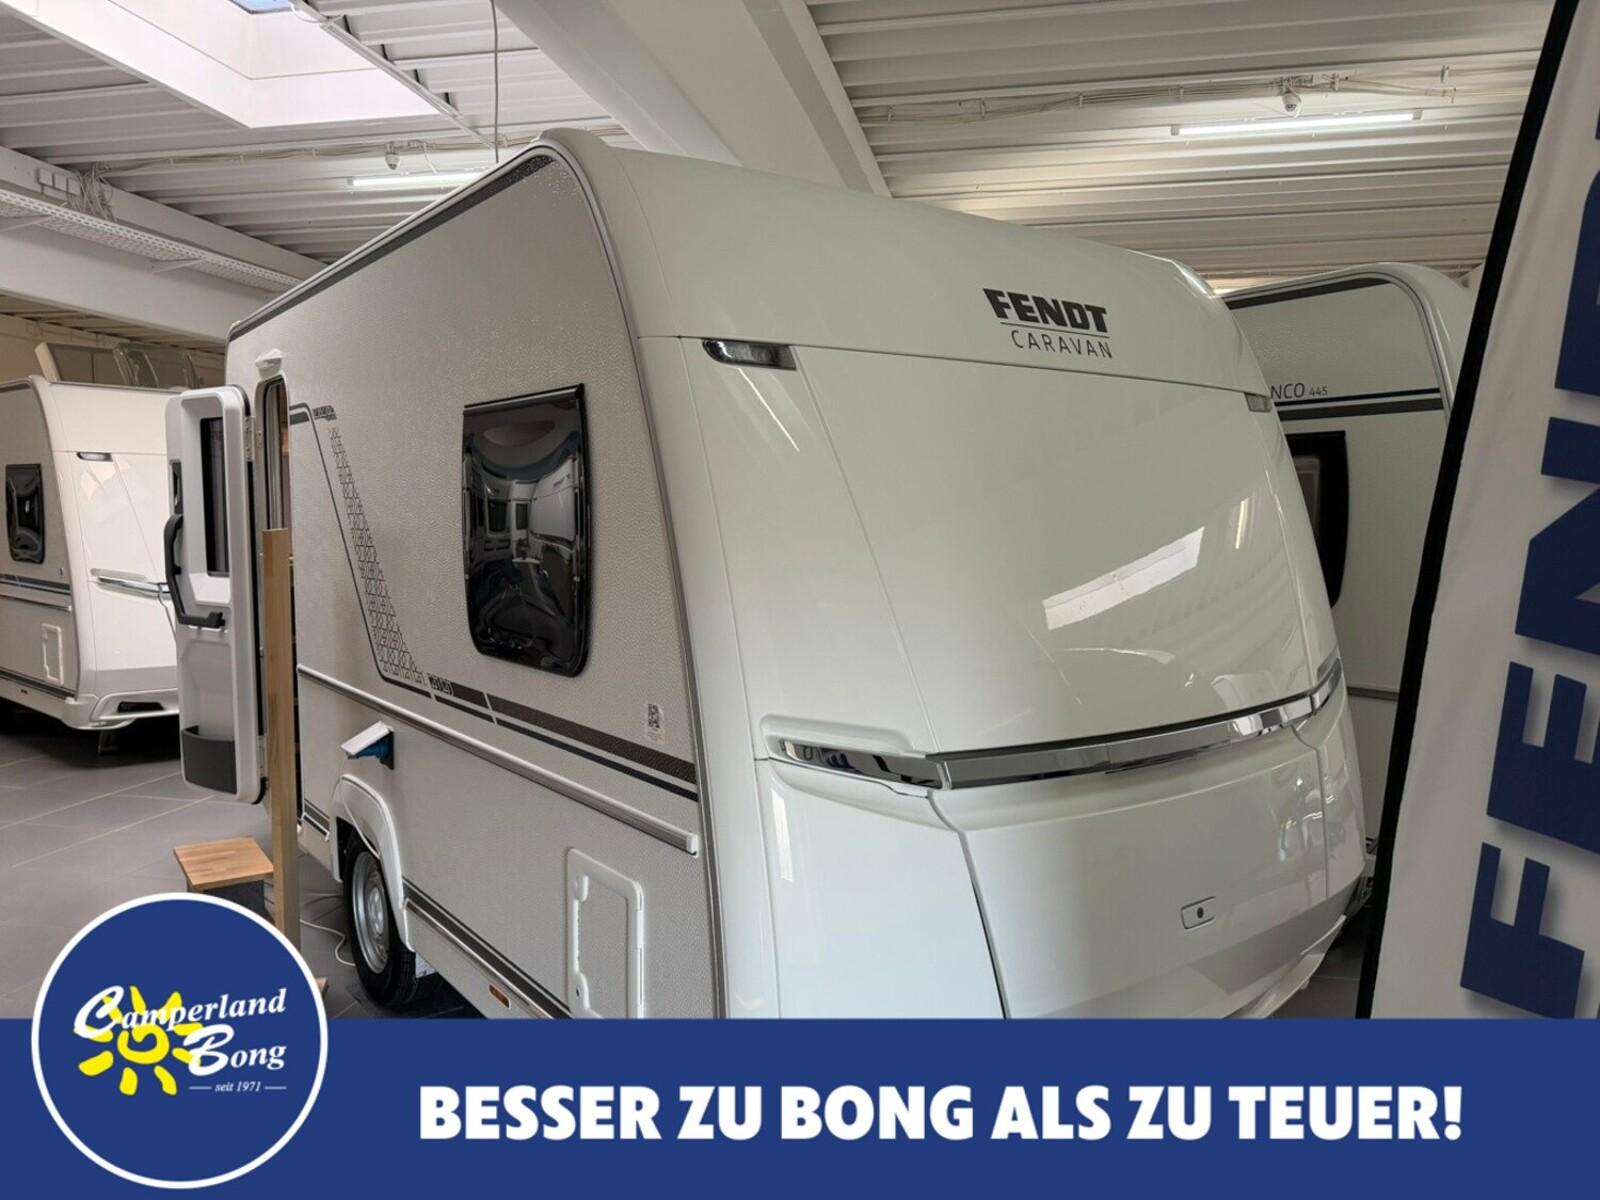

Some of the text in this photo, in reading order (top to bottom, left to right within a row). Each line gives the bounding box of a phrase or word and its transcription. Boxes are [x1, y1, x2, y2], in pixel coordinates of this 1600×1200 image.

[982, 287, 1108, 334] FENDT
[1011, 329, 1113, 359] CARAVAN
[1270, 382, 1328, 400] NCO 445
